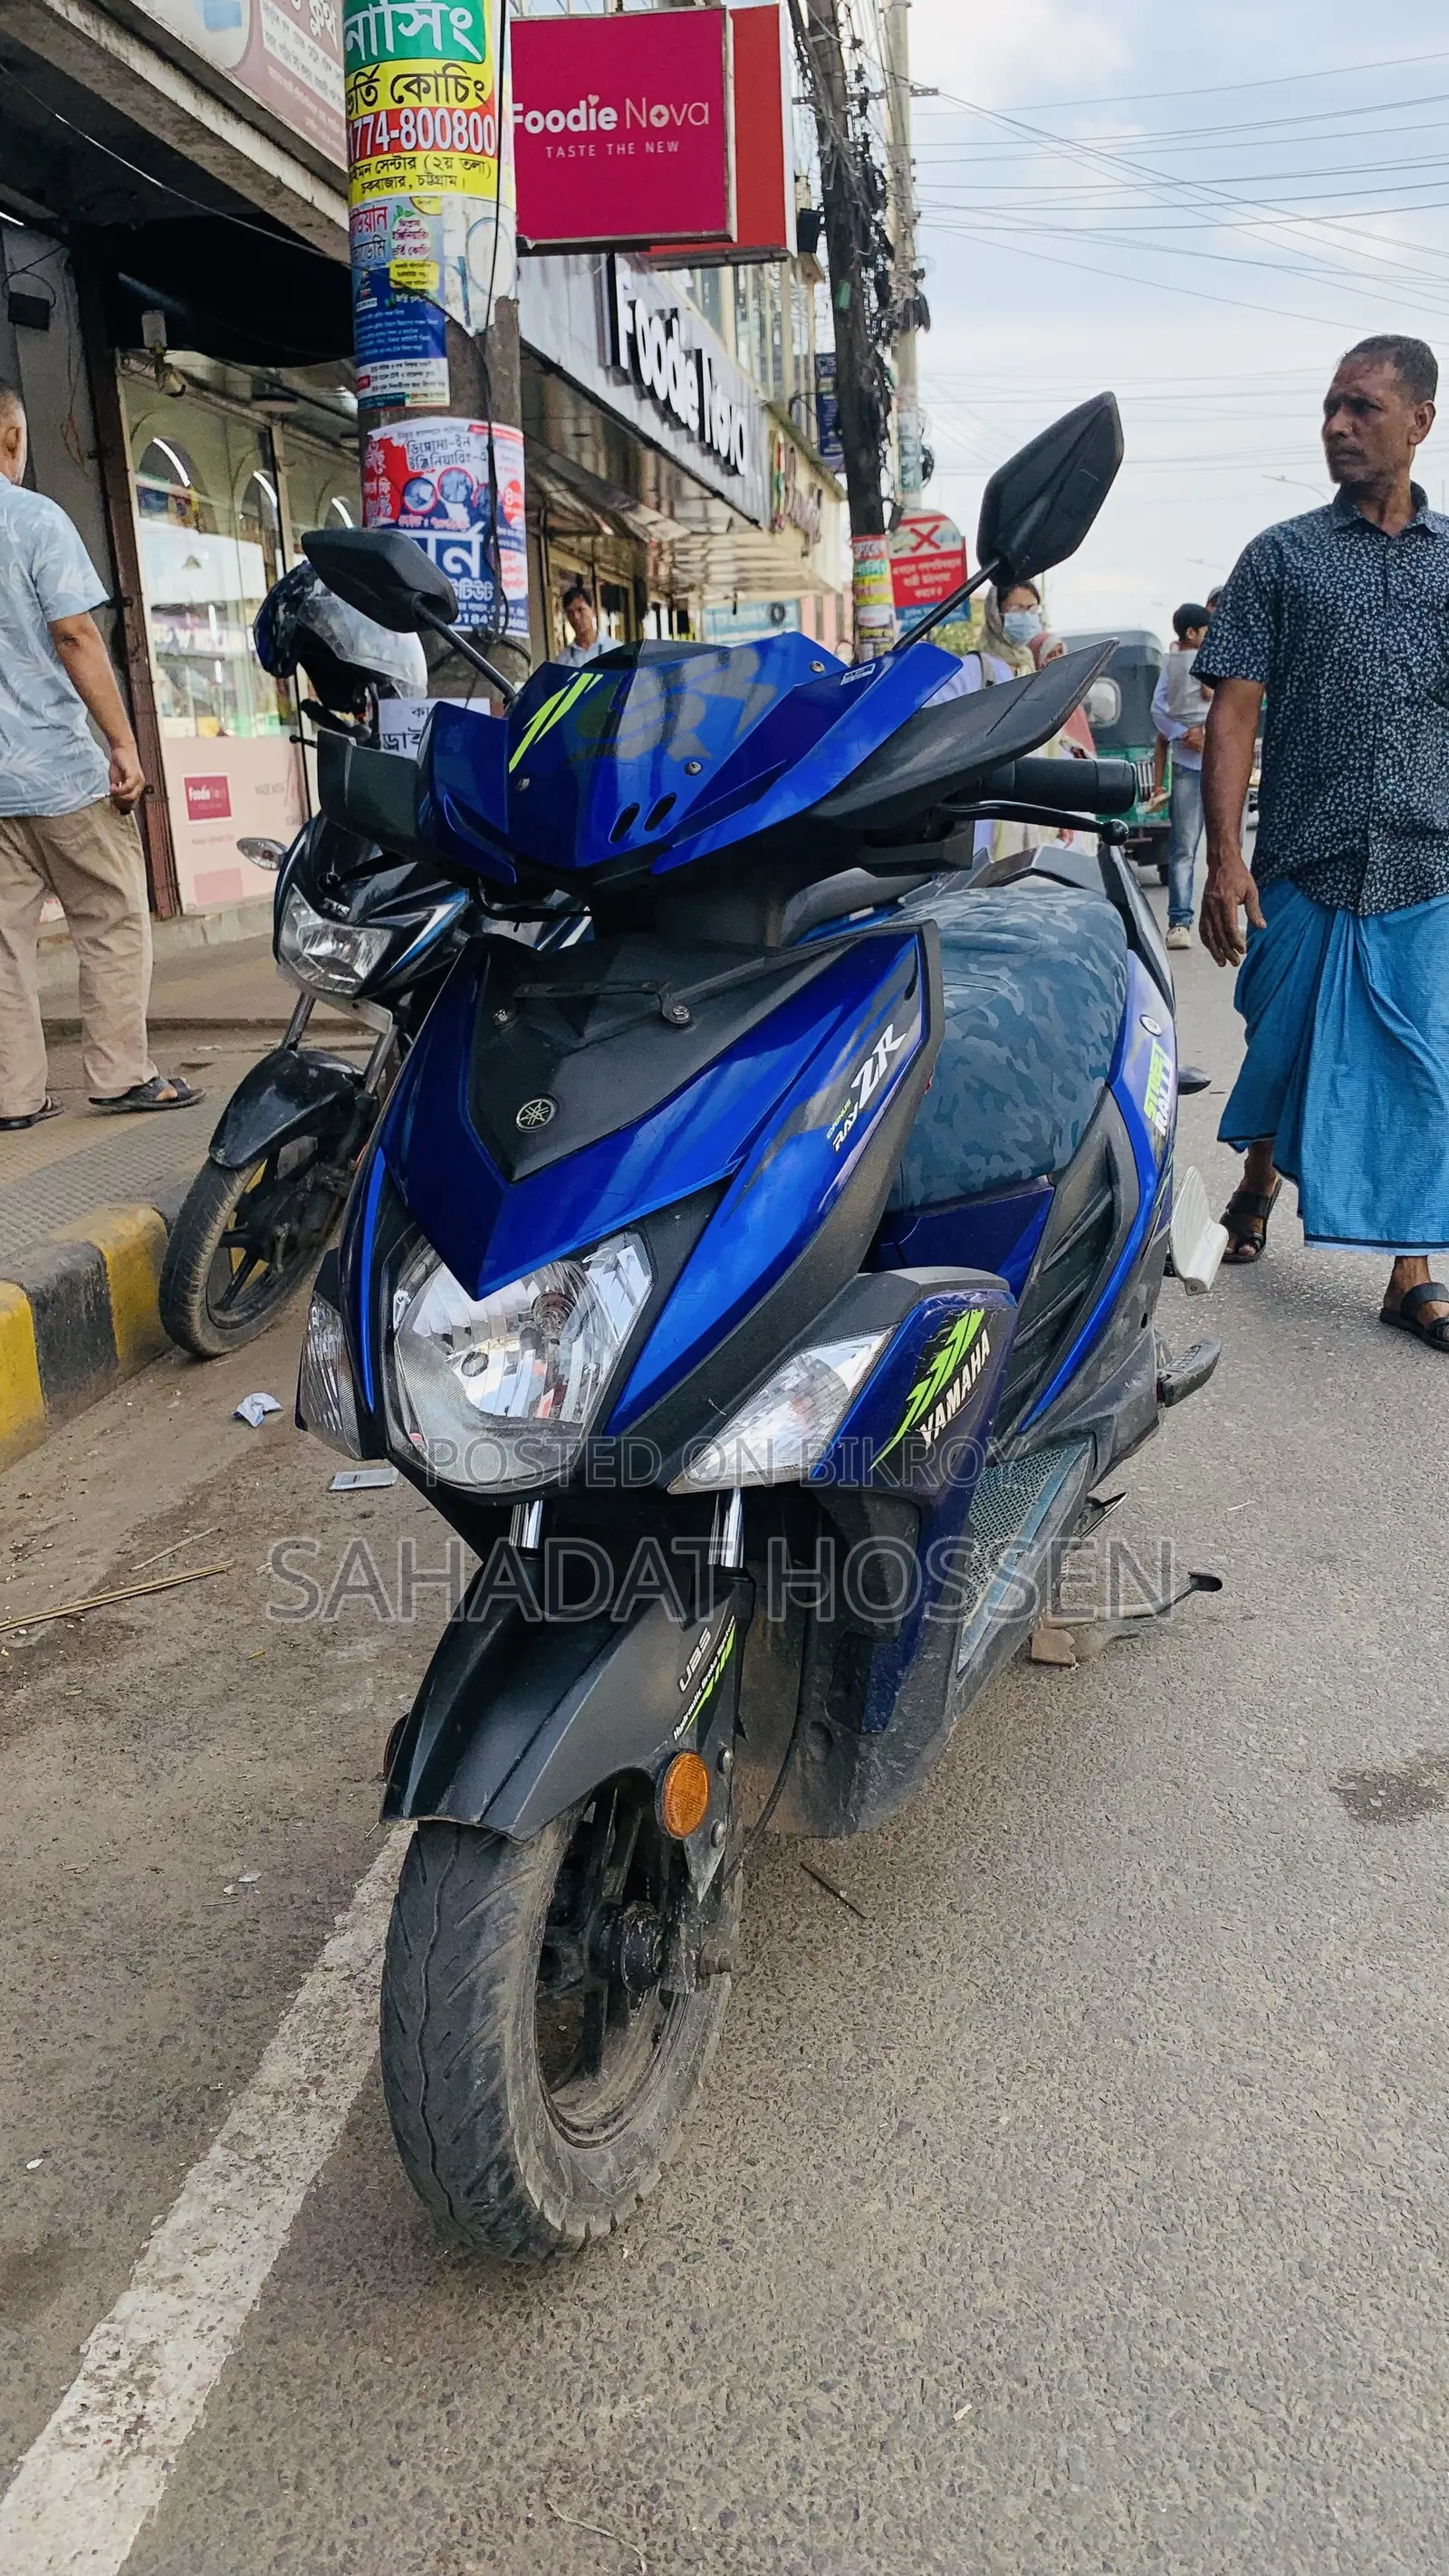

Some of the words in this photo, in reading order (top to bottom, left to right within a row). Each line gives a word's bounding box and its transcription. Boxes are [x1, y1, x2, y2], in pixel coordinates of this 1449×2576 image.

[390, 62, 485, 104] কোচিং
[513, 94, 619, 134] Foodie
[625, 96, 710, 129] Nova
[545, 145, 597, 158] TASTE
[606, 142, 636, 155] THE
[645, 140, 680, 153] NEW
[919, 1328, 991, 1451] YAMAHA
